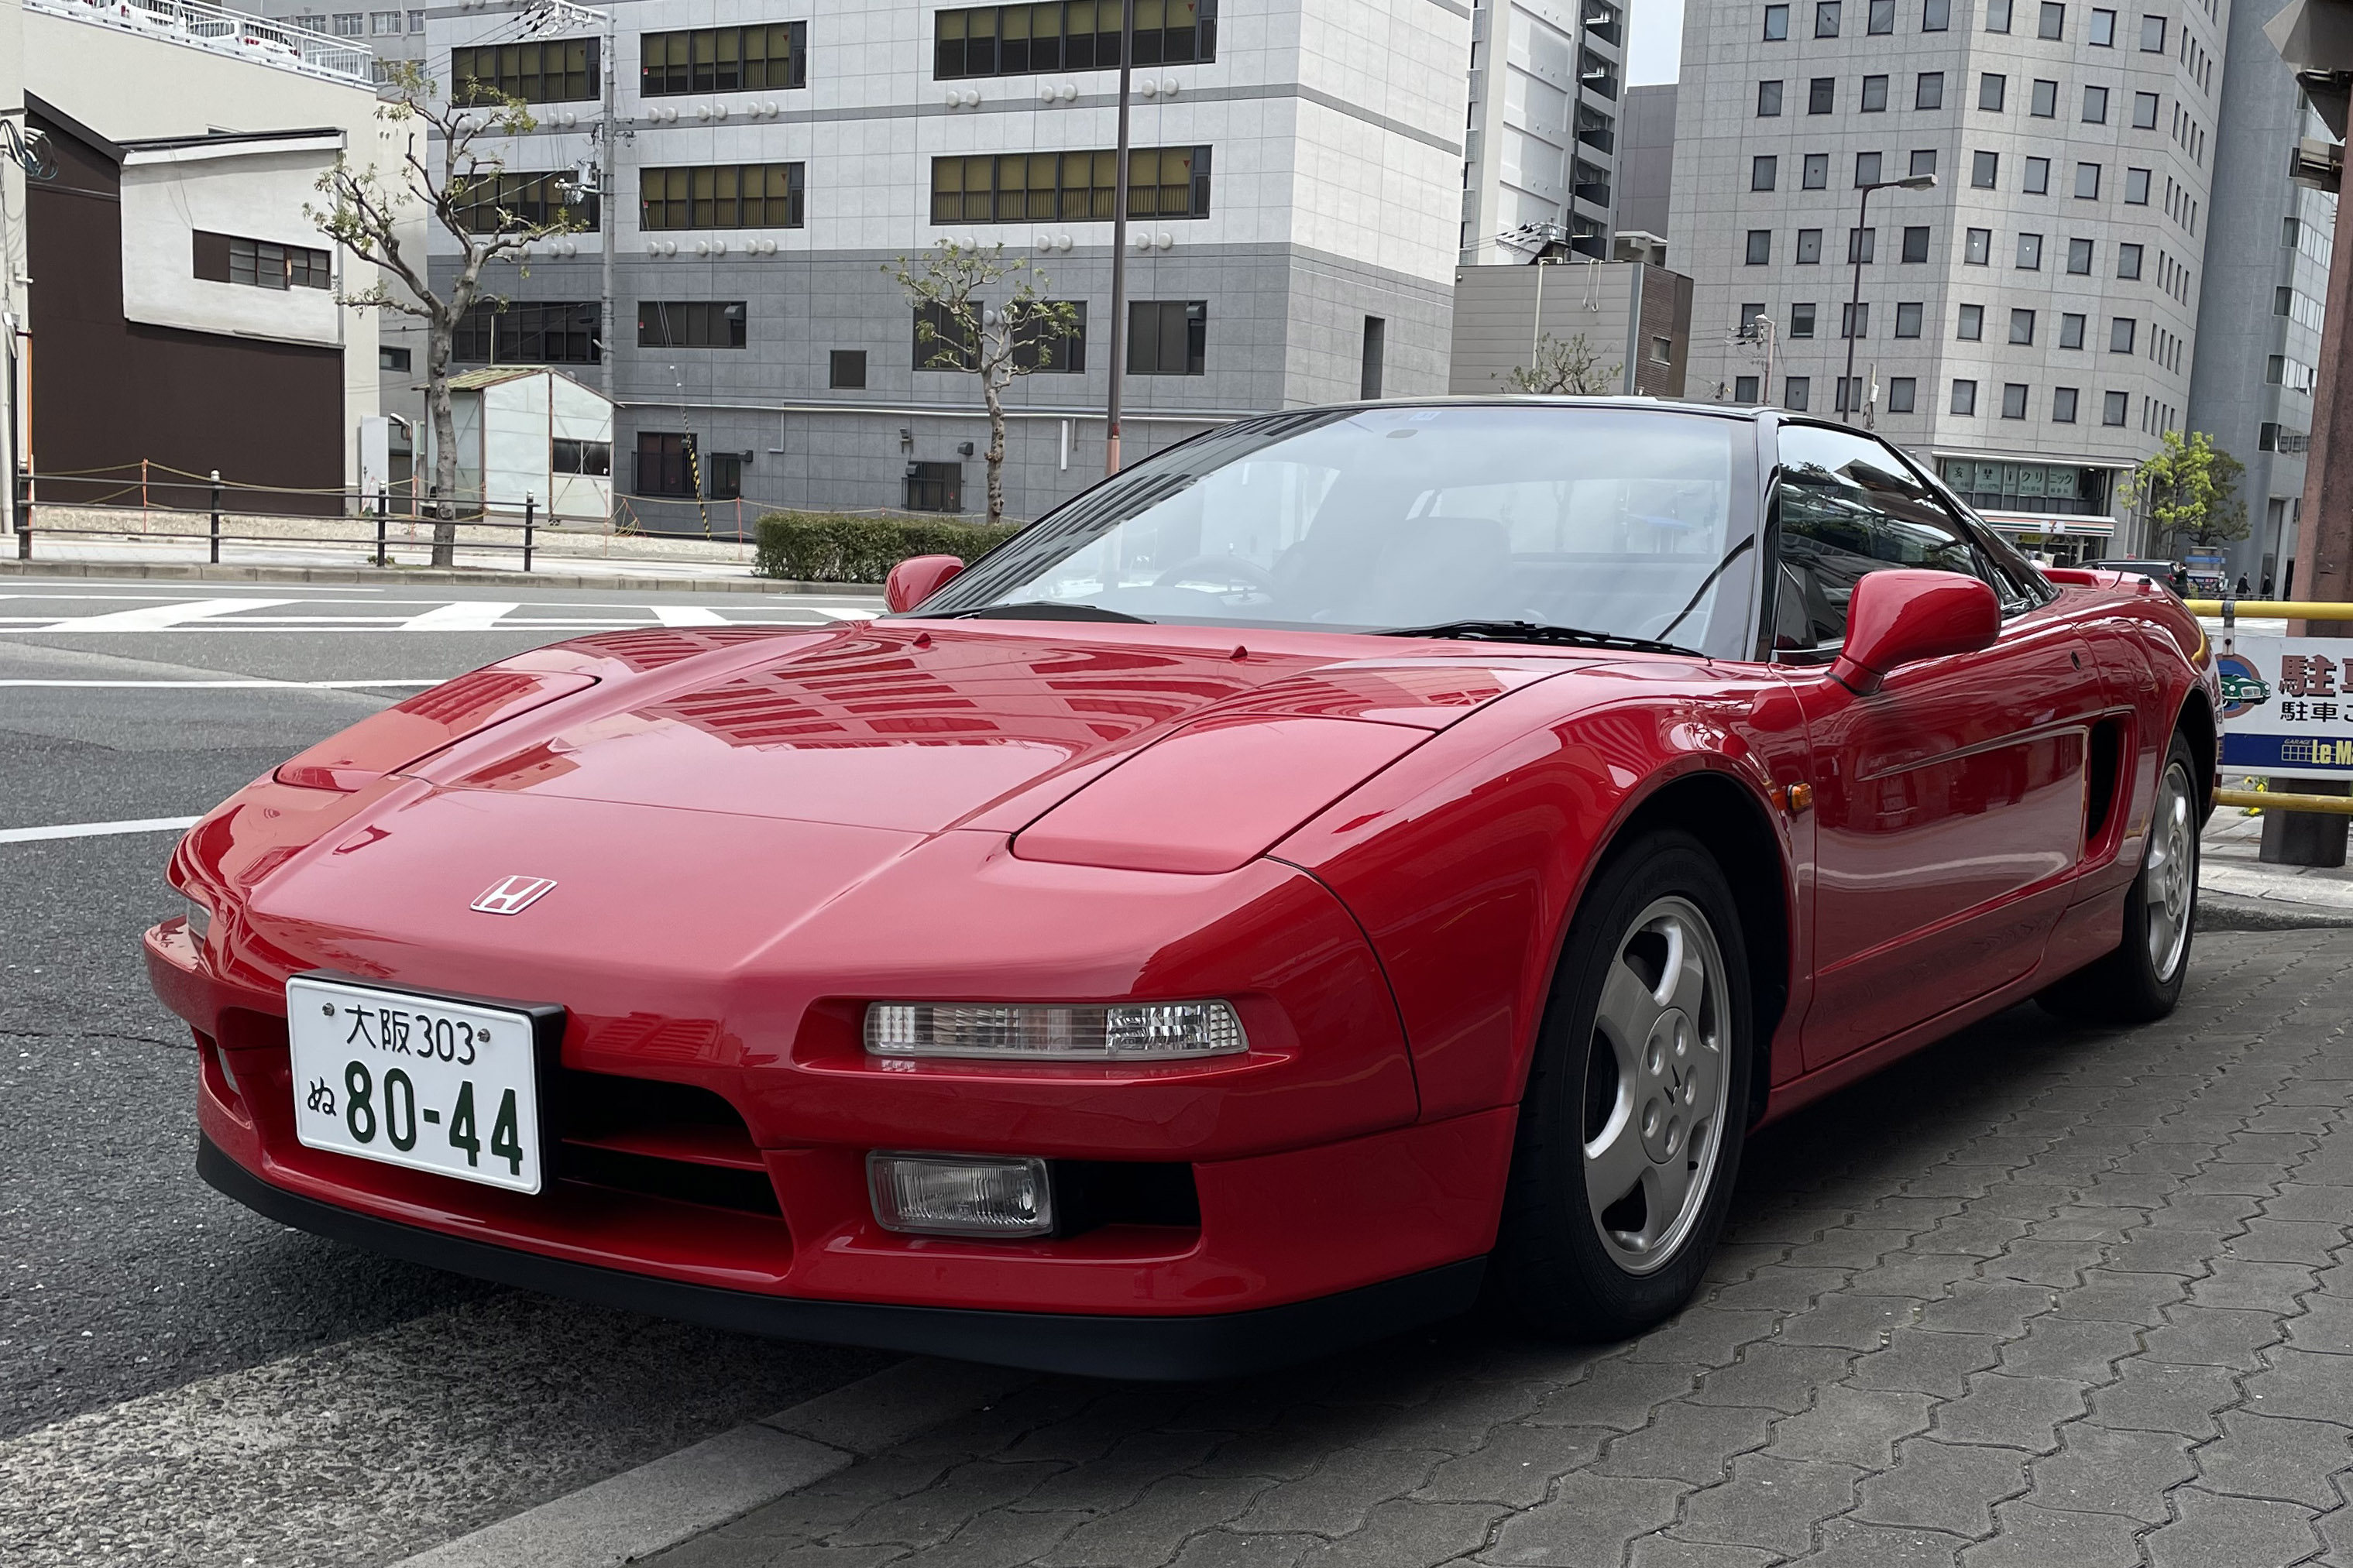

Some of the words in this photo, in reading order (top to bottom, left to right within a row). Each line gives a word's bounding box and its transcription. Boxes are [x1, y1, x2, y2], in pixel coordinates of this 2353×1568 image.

[2278, 654, 2353, 698] 駐
[2312, 739, 2332, 764] Le
[2335, 739, 2353, 765] M
[307, 1076, 337, 1117] ぬ
[345, 1060, 523, 1176] 80-44
